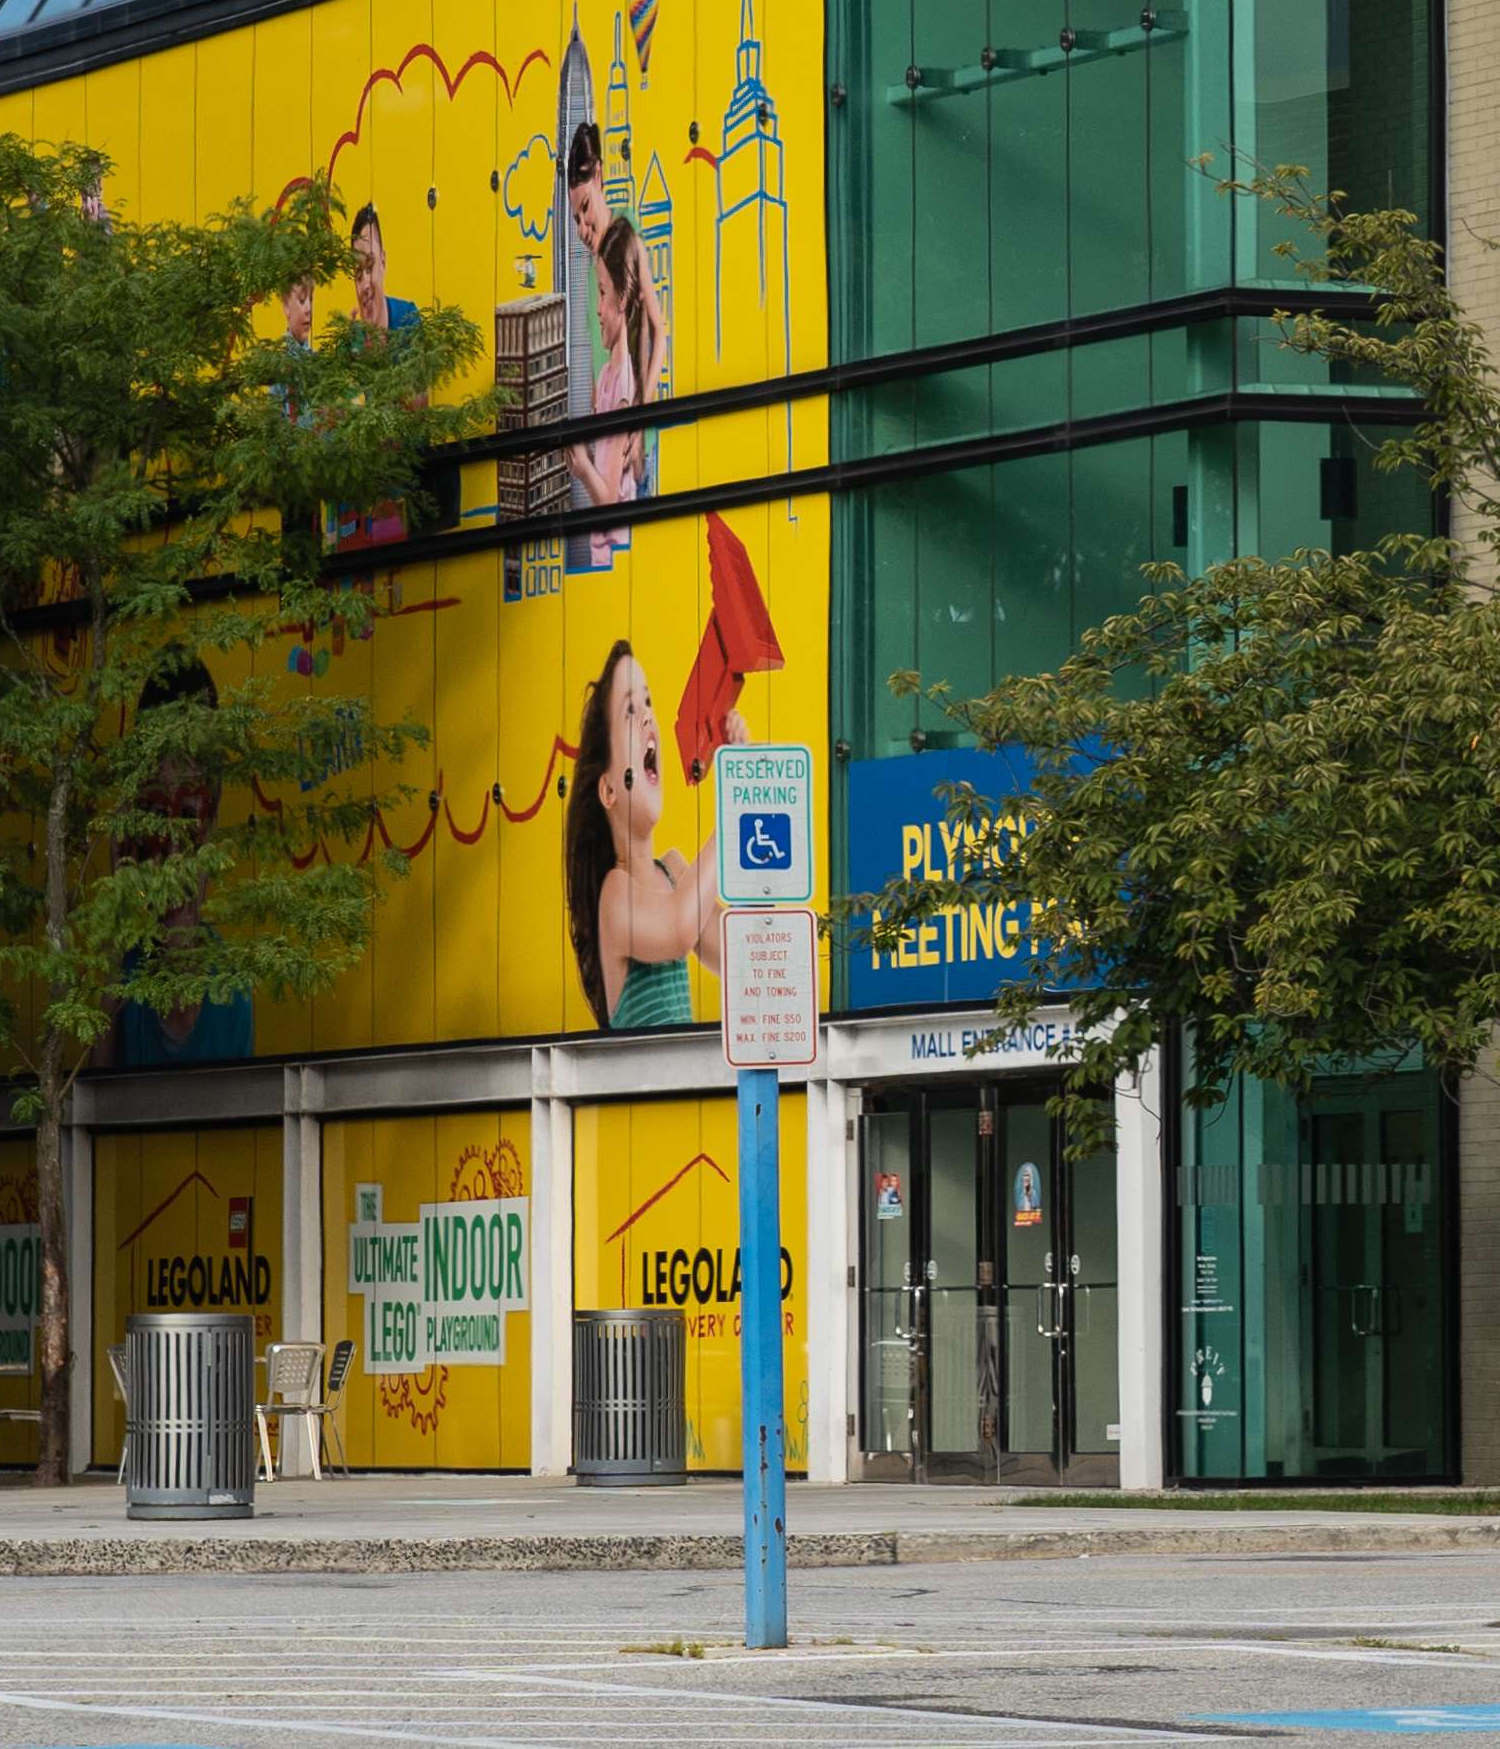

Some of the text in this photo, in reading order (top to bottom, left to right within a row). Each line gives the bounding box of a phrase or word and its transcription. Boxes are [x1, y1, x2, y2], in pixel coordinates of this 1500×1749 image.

[726, 759, 805, 779] RESERVED
[733, 787, 797, 804] PARKING
[746, 933, 792, 943] VIOLATORS
[750, 950, 788, 960] SUBJECT
[752, 969, 787, 979] TO FINE
[744, 987, 797, 997] AND TOWING
[762, 1014, 782, 1024] FINE
[762, 1032, 781, 1042] FINE
[912, 1032, 956, 1059] MALL
[361, 1192, 377, 1221] THE
[147, 1197, 271, 1307] LEGOLAND
[354, 1235, 418, 1283] ULTIMATE
[424, 1213, 523, 1301] INDOOR
[426, 1314, 499, 1352] PLAYGROUND
